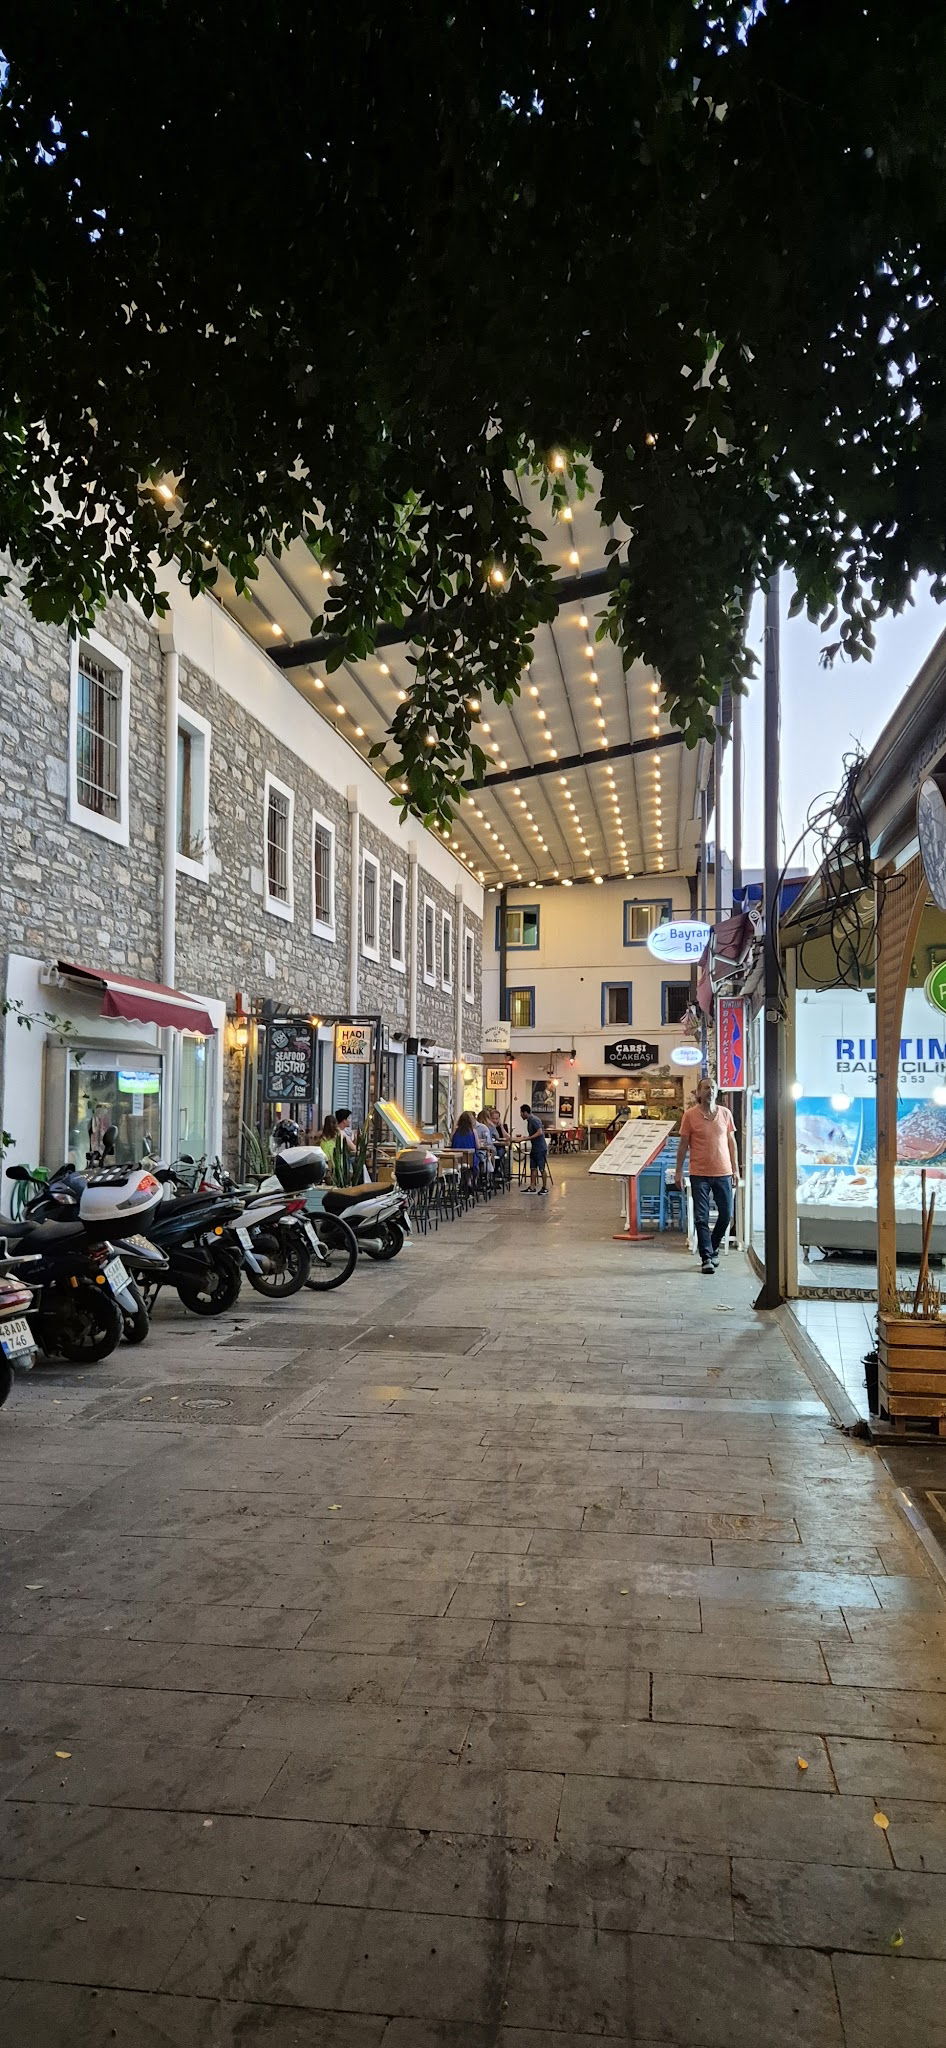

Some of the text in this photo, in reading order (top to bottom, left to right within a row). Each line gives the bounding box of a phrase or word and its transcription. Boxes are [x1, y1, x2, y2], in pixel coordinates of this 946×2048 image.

[615, 1044, 647, 1055] ÇARŞI
[275, 1051, 306, 1061] SEAFOOD
[609, 1053, 654, 1061] OCAKBAŞI
[274, 1060, 306, 1074] BISTRO
[8, 1335, 27, 1349] 746
